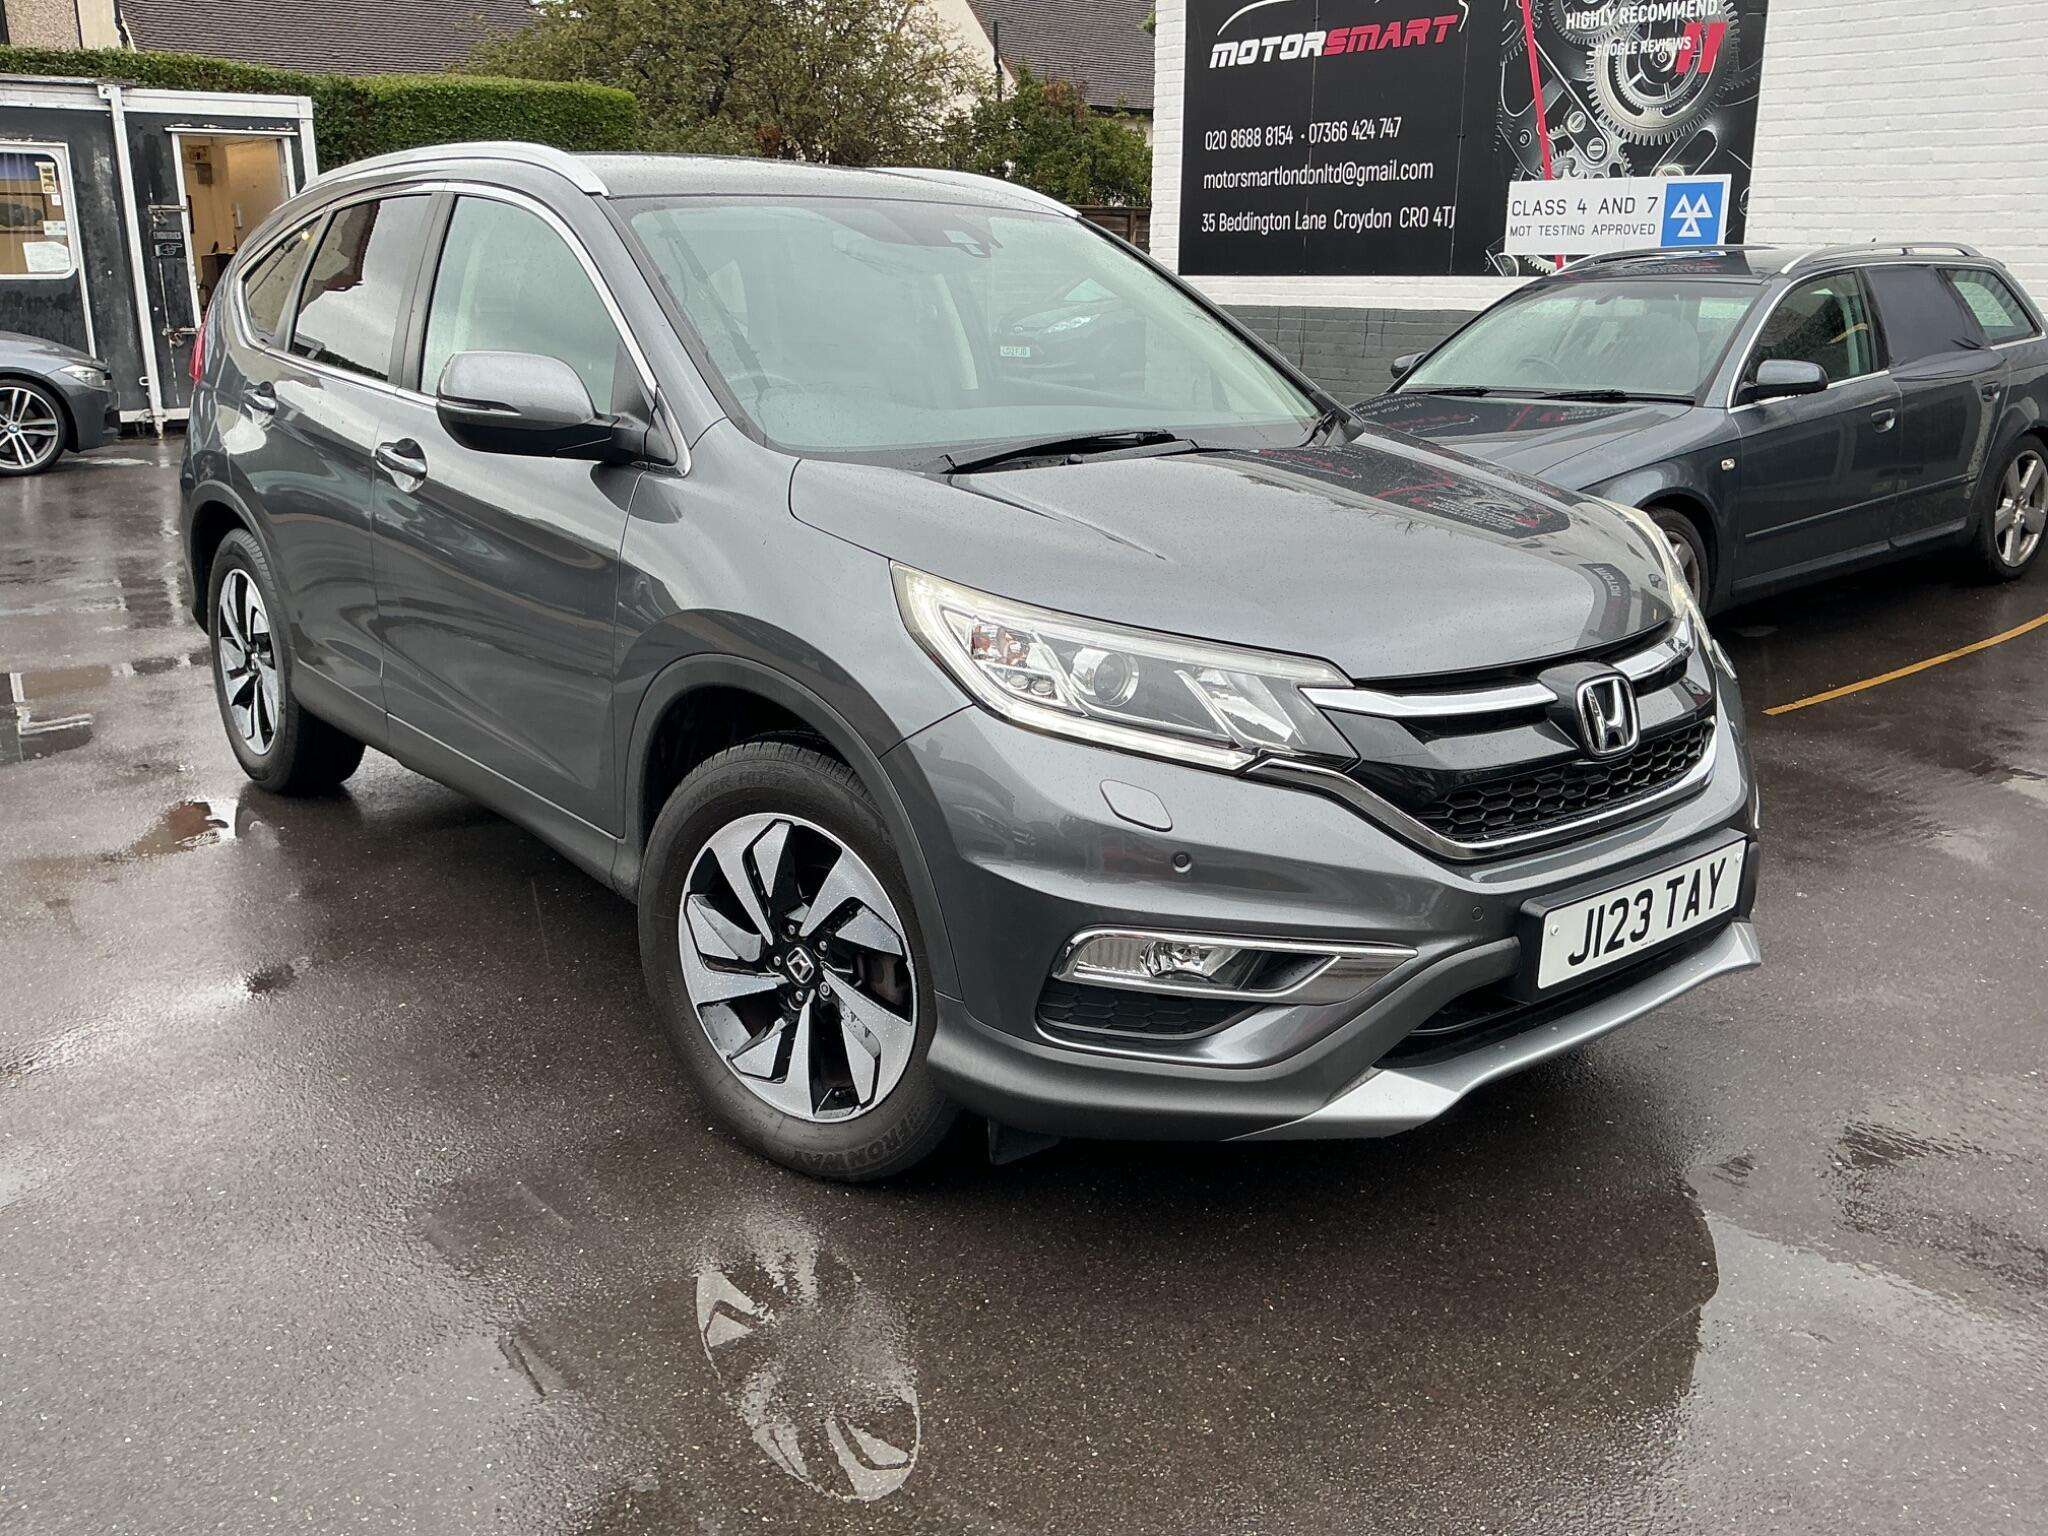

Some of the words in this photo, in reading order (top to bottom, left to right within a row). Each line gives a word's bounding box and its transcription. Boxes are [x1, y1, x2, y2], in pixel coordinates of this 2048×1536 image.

[1566, 9, 1616, 30] HIGHLY
[1209, 14, 1458, 69] MOTORSMART
[1640, 36, 1692, 54] REVIEWS
[1205, 131, 1227, 151] 020
[1230, 128, 1262, 149] 8688
[1265, 125, 1293, 147] 8154
[1308, 121, 1348, 144] 07366
[1351, 119, 1375, 141] 424
[1379, 116, 1402, 139] 747
[1203, 160, 1434, 189] motorsmartlondonltd@gmail.com
[1201, 212, 1216, 233] 35
[1219, 210, 1291, 235] Beddington
[1295, 210, 1327, 231] Lane
[1333, 208, 1392, 234] Croydon
[1432, 205, 1456, 229] 4TJ
[1511, 199, 1567, 216] CLASS
[1577, 200, 1587, 213] 4
[1598, 198, 1636, 214] AND
[1647, 197, 1658, 214] 7
[1509, 225, 1531, 237] MOT
[1538, 224, 1585, 236] TESTING
[1591, 223, 1656, 236] APPROVED
[1665, 857, 1727, 929] TAY
